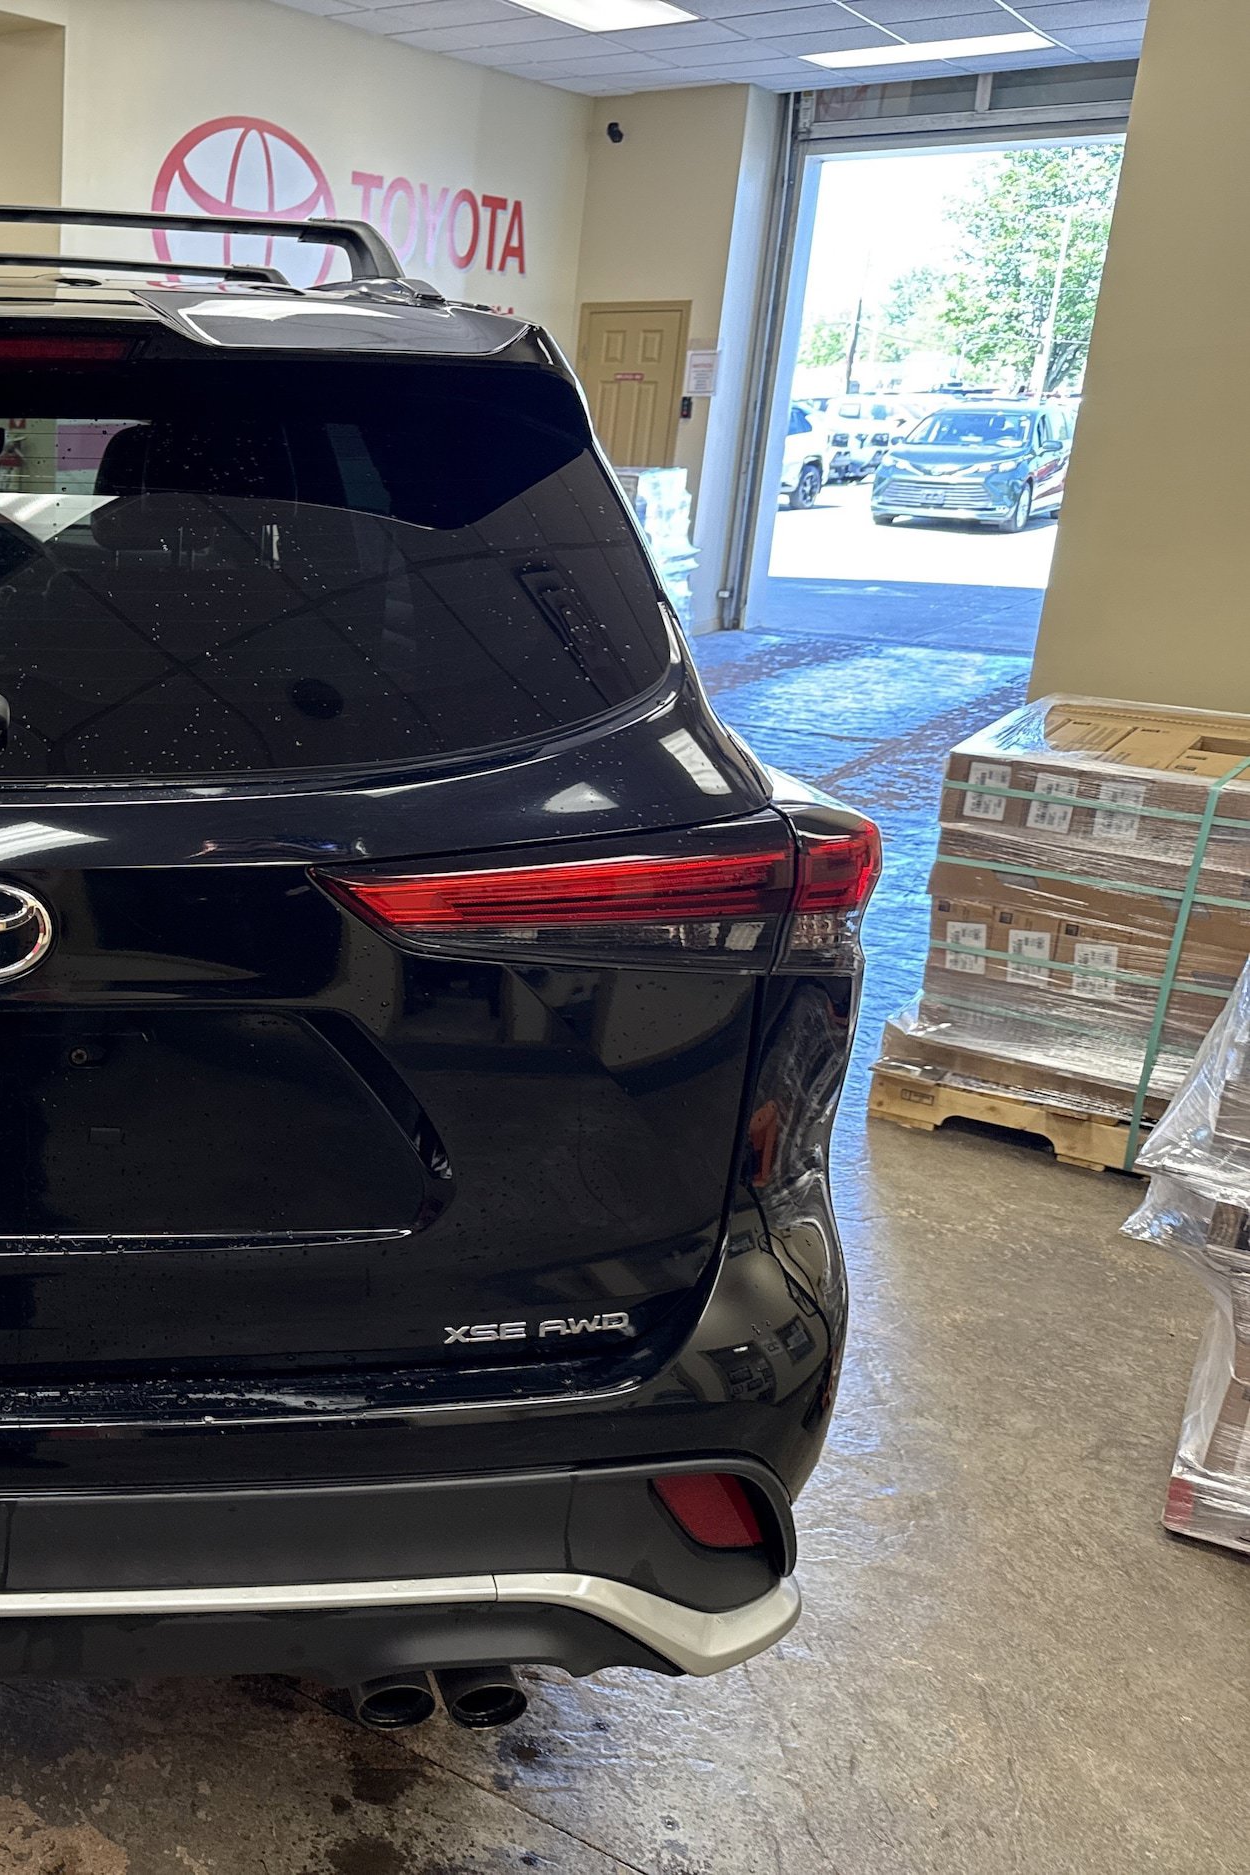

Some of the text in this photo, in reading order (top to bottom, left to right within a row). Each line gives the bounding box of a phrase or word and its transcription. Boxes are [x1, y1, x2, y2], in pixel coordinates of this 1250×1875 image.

[351, 170, 526, 275] TOYOTA
[443, 1311, 630, 1344] XSE AWD
